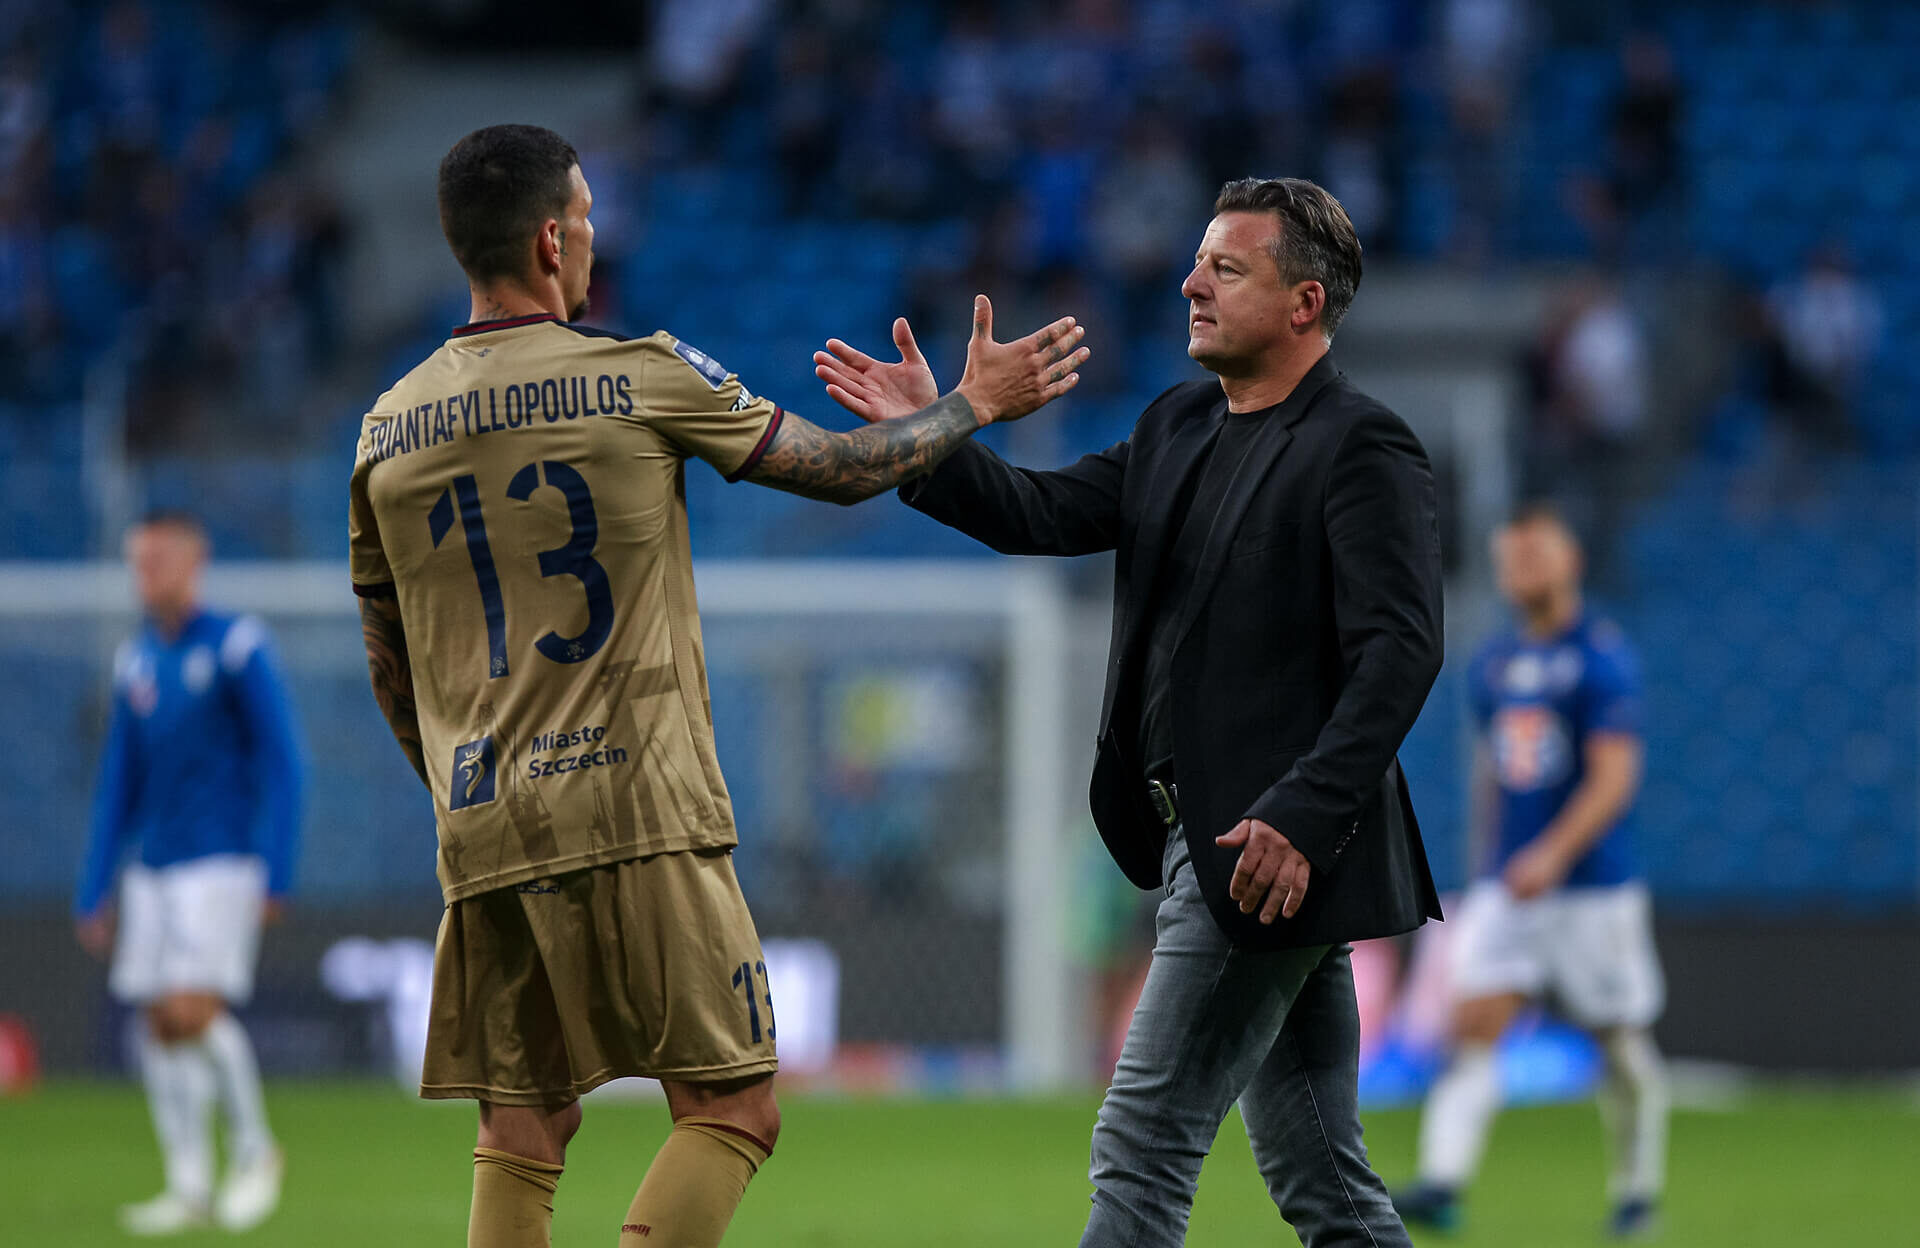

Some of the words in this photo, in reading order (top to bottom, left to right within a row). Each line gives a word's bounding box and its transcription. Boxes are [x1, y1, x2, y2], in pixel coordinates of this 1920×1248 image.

[367, 374, 634, 466] TRIANTAFYLLOPOULOS
[428, 460, 615, 679] 13
[528, 745, 628, 779] Szczecin
[531, 725, 606, 755] Miasto
